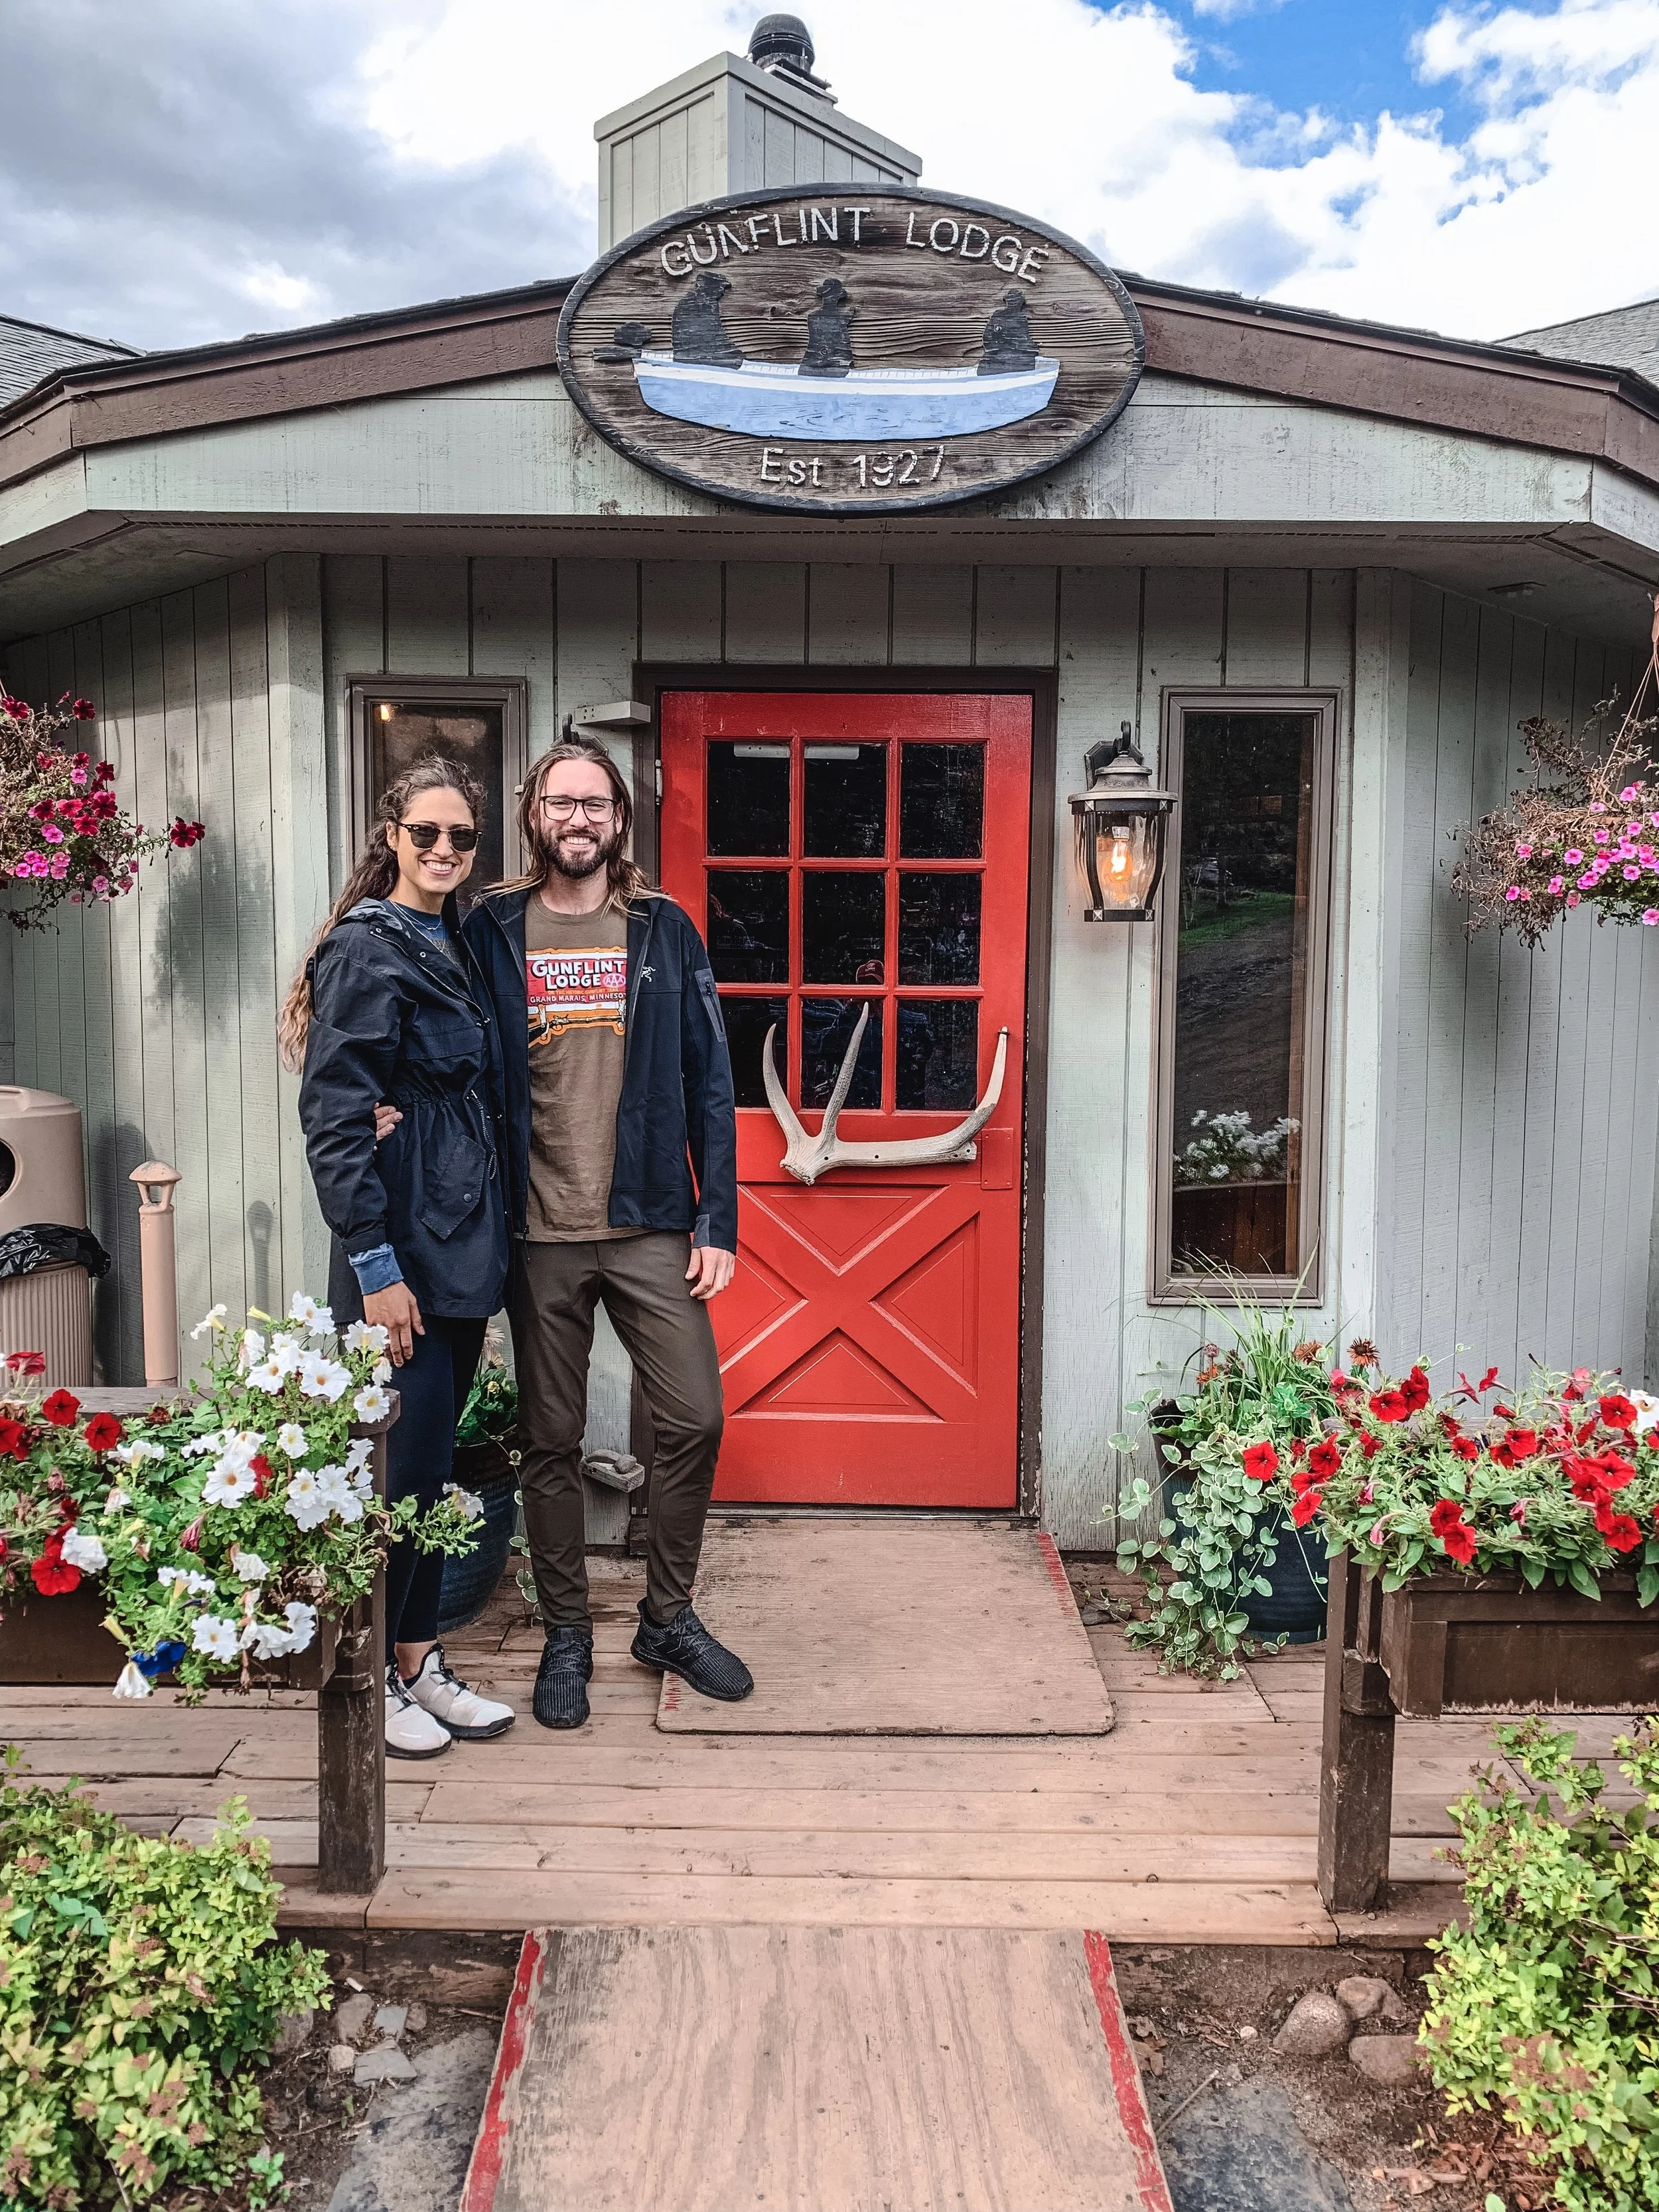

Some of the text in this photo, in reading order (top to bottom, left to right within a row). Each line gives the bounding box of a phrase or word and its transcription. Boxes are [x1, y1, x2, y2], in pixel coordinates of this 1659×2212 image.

[661, 206, 1049, 283] GUNFLINT LODGE
[759, 445, 945, 488] Est 1927
[532, 960, 624, 977] GUNFLINT
[546, 974, 601, 990] LODGE
[605, 976, 624, 986] AAA
